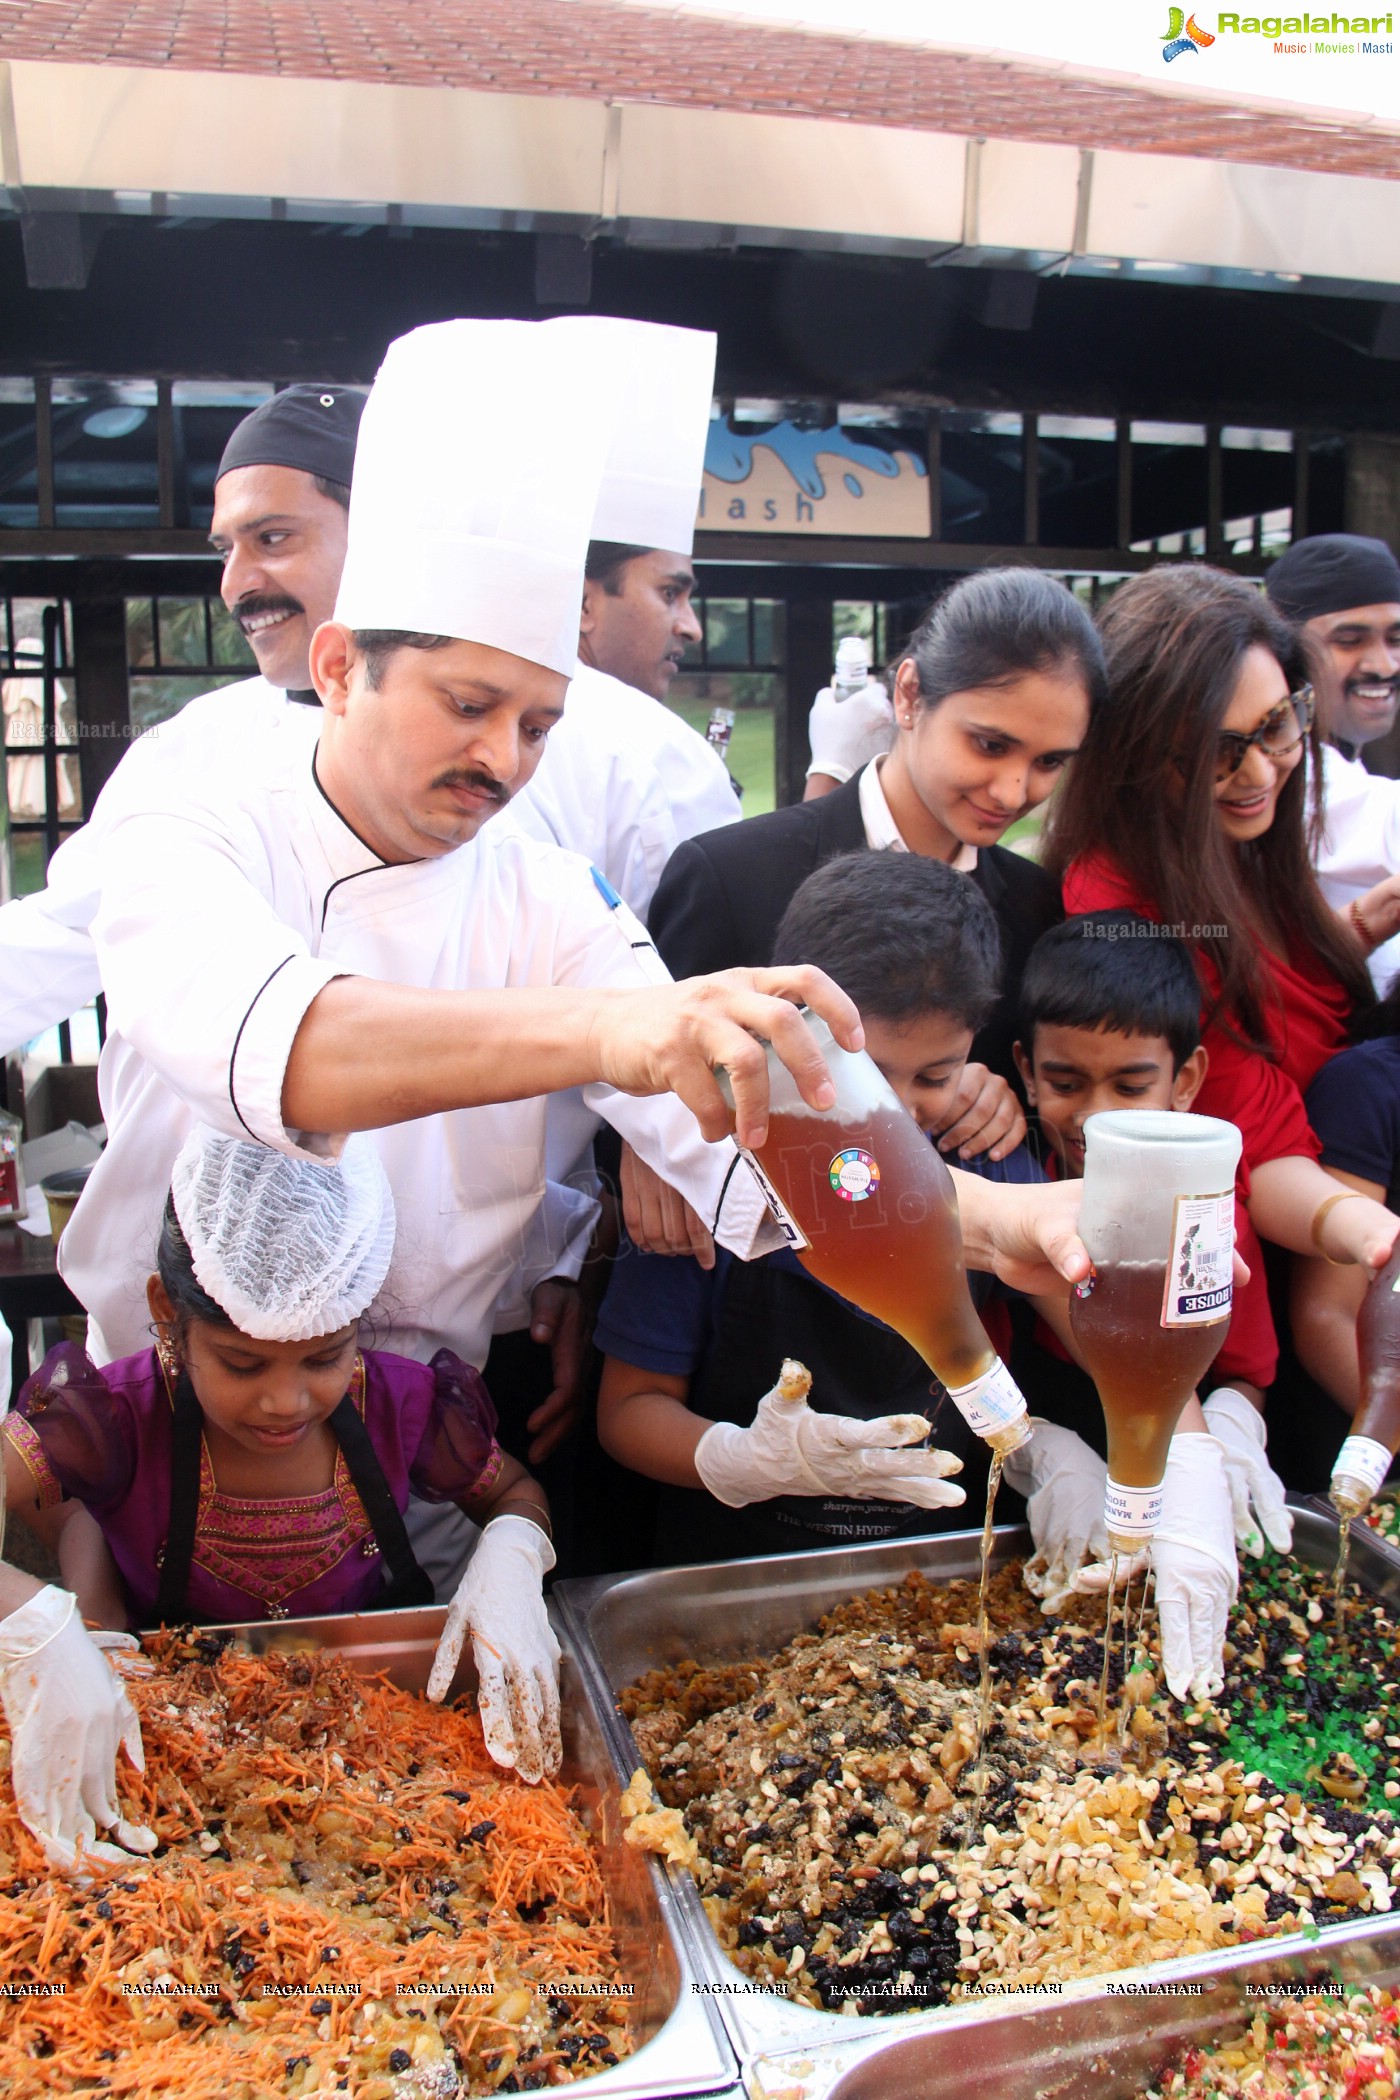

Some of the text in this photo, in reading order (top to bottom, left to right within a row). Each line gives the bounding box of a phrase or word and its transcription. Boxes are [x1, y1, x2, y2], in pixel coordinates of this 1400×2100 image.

[698, 488, 813, 522] lash
[1185, 1287, 1230, 1311] HOUSE
[823, 1501, 864, 1513] sharpen
[864, 1504, 890, 1514] your
[803, 1521, 854, 1535] WESTIN
